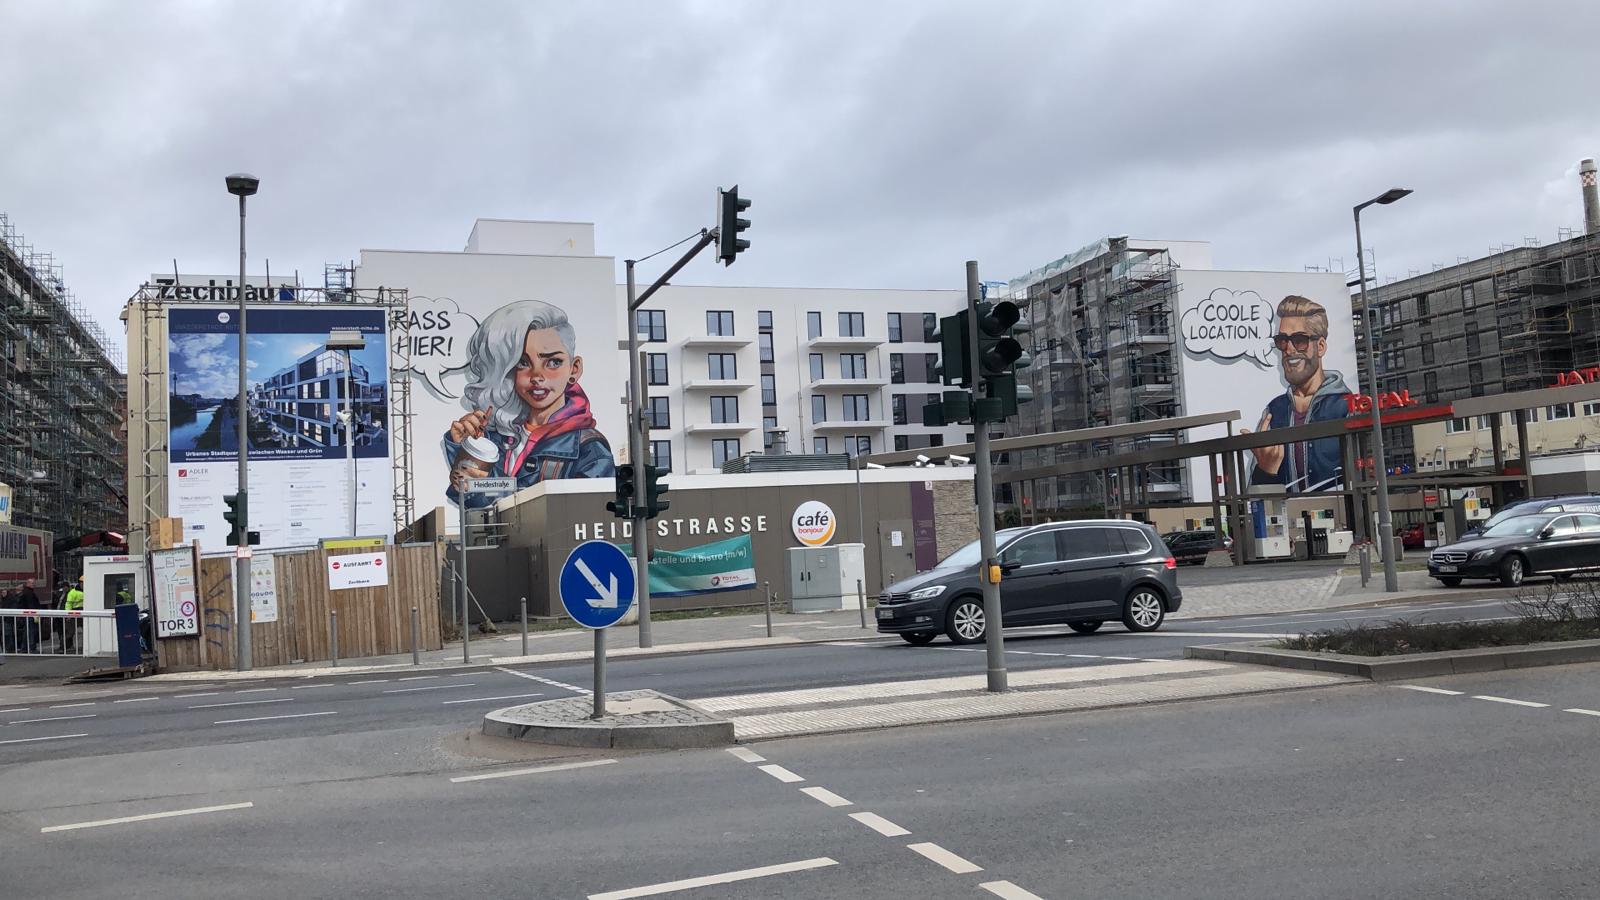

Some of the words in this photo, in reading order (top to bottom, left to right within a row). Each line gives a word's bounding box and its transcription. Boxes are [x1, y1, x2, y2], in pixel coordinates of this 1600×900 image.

[156, 279, 275, 300] Zechbau
[1203, 304, 1260, 321] COOLE
[1190, 325, 1262, 339] LOCATION.
[397, 336, 453, 357] HIER!
[1344, 389, 1418, 415] TOTAL
[797, 511, 829, 526] café
[574, 515, 767, 540] HEIDSTRASSE
[798, 527, 824, 535] bonjour
[680, 554, 696, 563] und
[160, 619, 186, 631] TOR
[187, 618, 195, 629] 3
